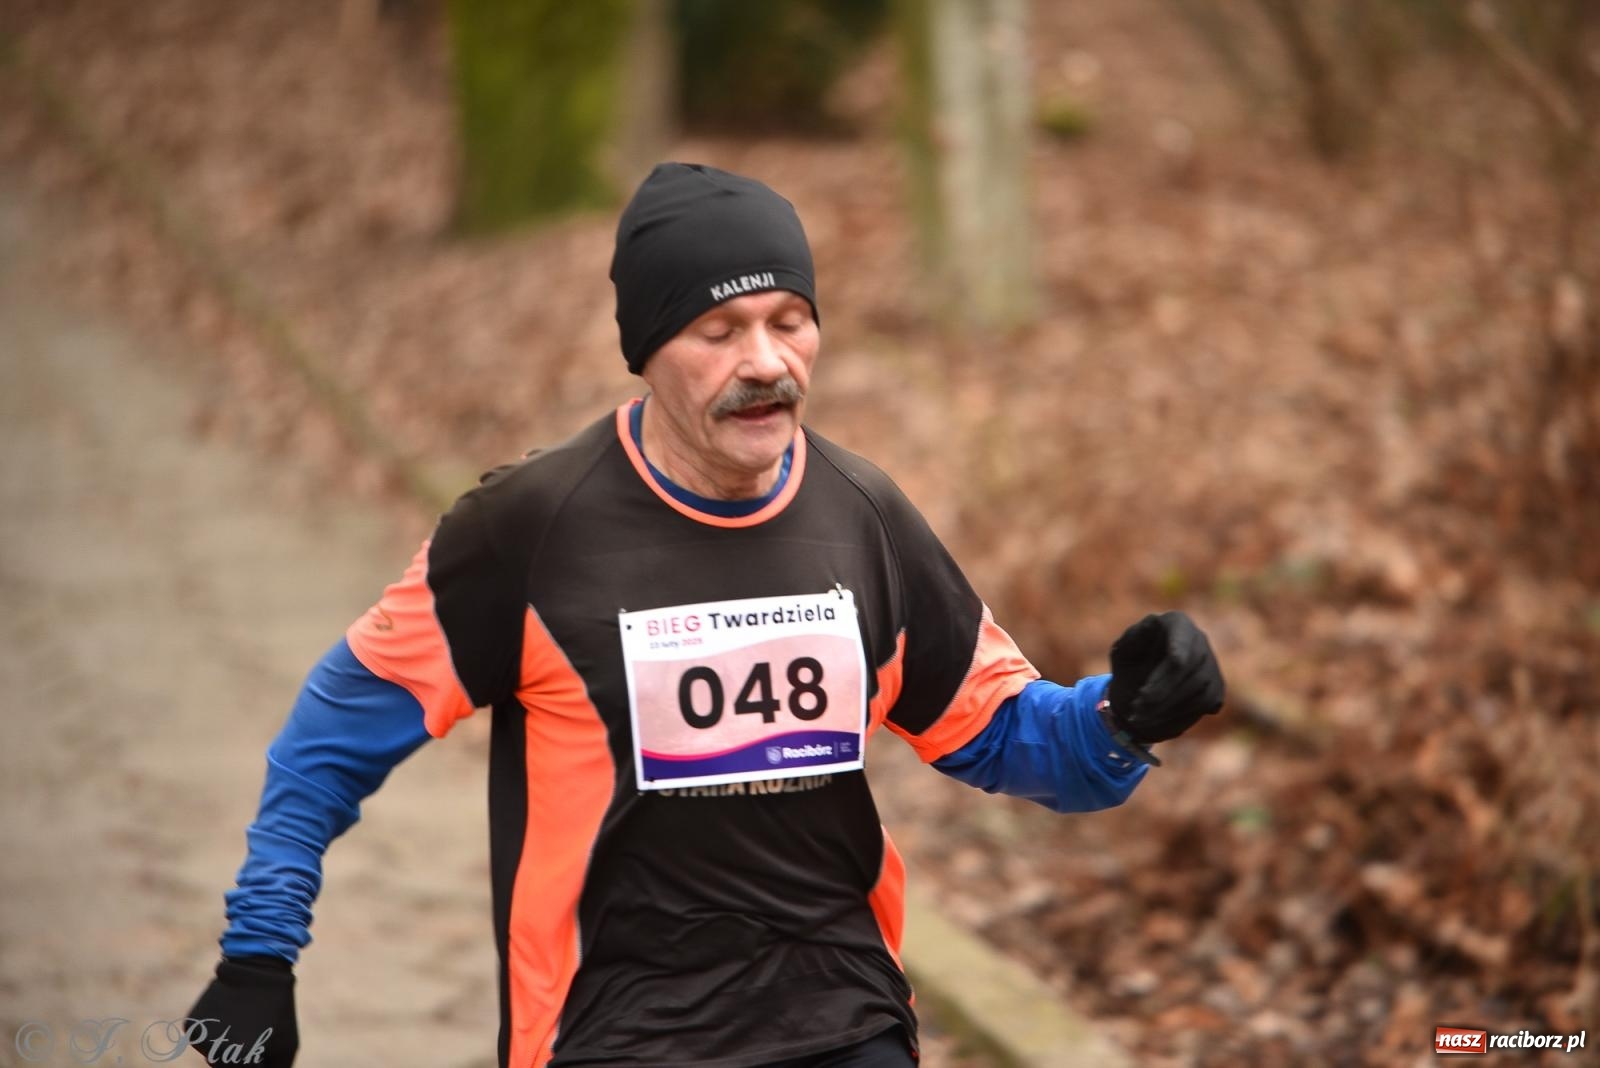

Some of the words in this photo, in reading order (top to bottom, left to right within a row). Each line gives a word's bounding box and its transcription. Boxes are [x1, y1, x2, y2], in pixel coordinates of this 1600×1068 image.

[710, 271, 776, 302] KALENJI
[646, 615, 701, 636] BIEG
[708, 604, 836, 629] Twardziela
[678, 656, 828, 729] 048
